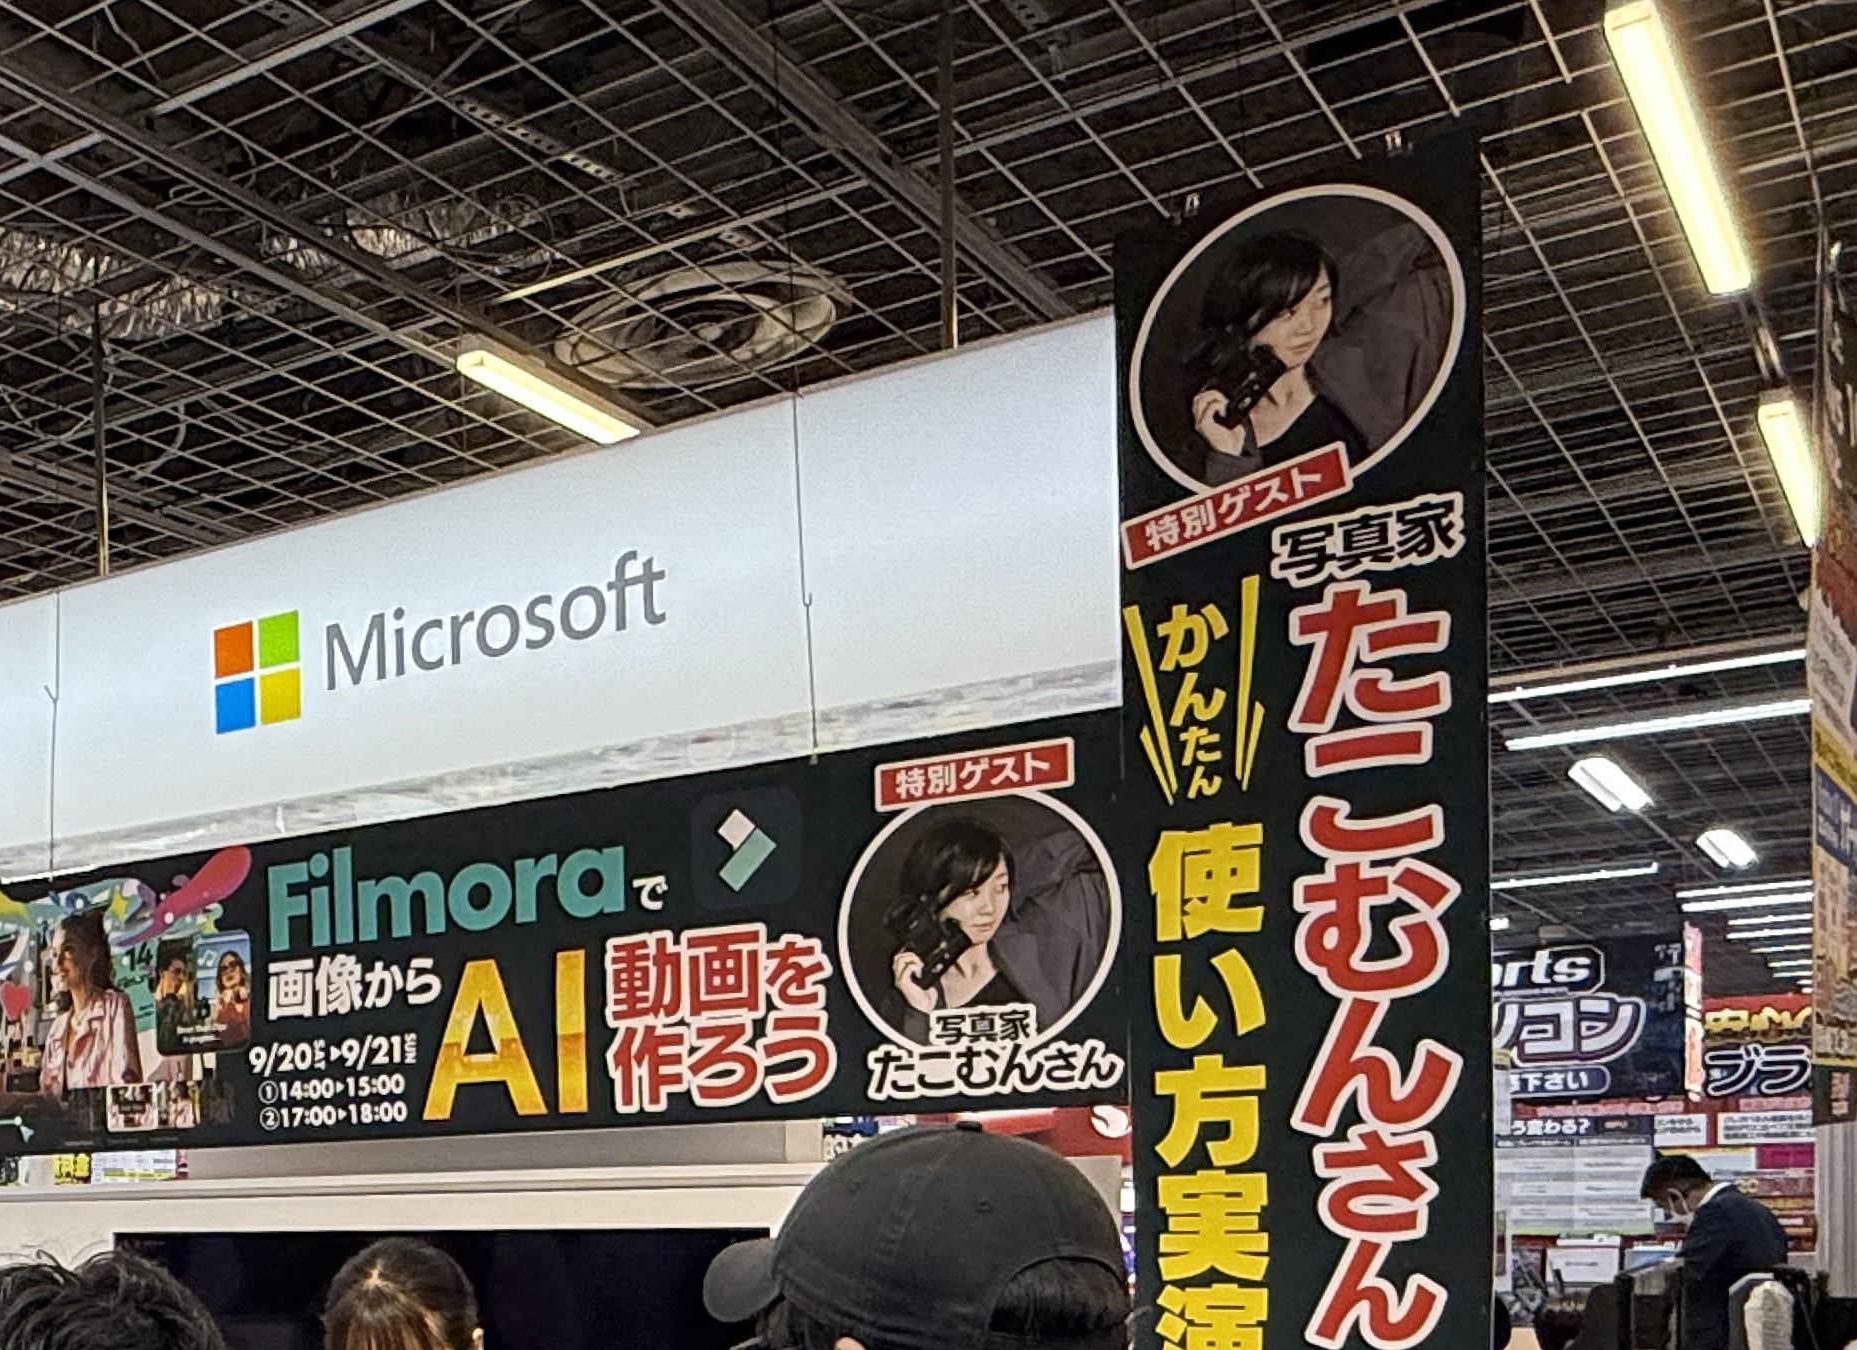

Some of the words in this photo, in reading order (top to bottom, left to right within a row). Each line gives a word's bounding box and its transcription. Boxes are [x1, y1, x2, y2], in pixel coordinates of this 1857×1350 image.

[1142, 461, 1327, 553] 特別ゲスト
[1271, 490, 1467, 587] 写真家
[324, 549, 667, 691] Microsoft
[1156, 601, 1232, 801] かんたん
[894, 750, 1056, 801] 特別ゲスト
[248, 1042, 312, 1077] 9/20
[341, 1034, 402, 1070] 9/21
[266, 951, 443, 1021] 画像から
[422, 947, 588, 1122] AI
[606, 923, 828, 1024] 動画を
[927, 1002, 1040, 1055] 写真家
[346, 1073, 406, 1097] 15:00
[608, 1010, 836, 1115] 作ろう
[865, 1034, 1124, 1100] たこむんさん
[348, 1101, 408, 1125] 18:00
